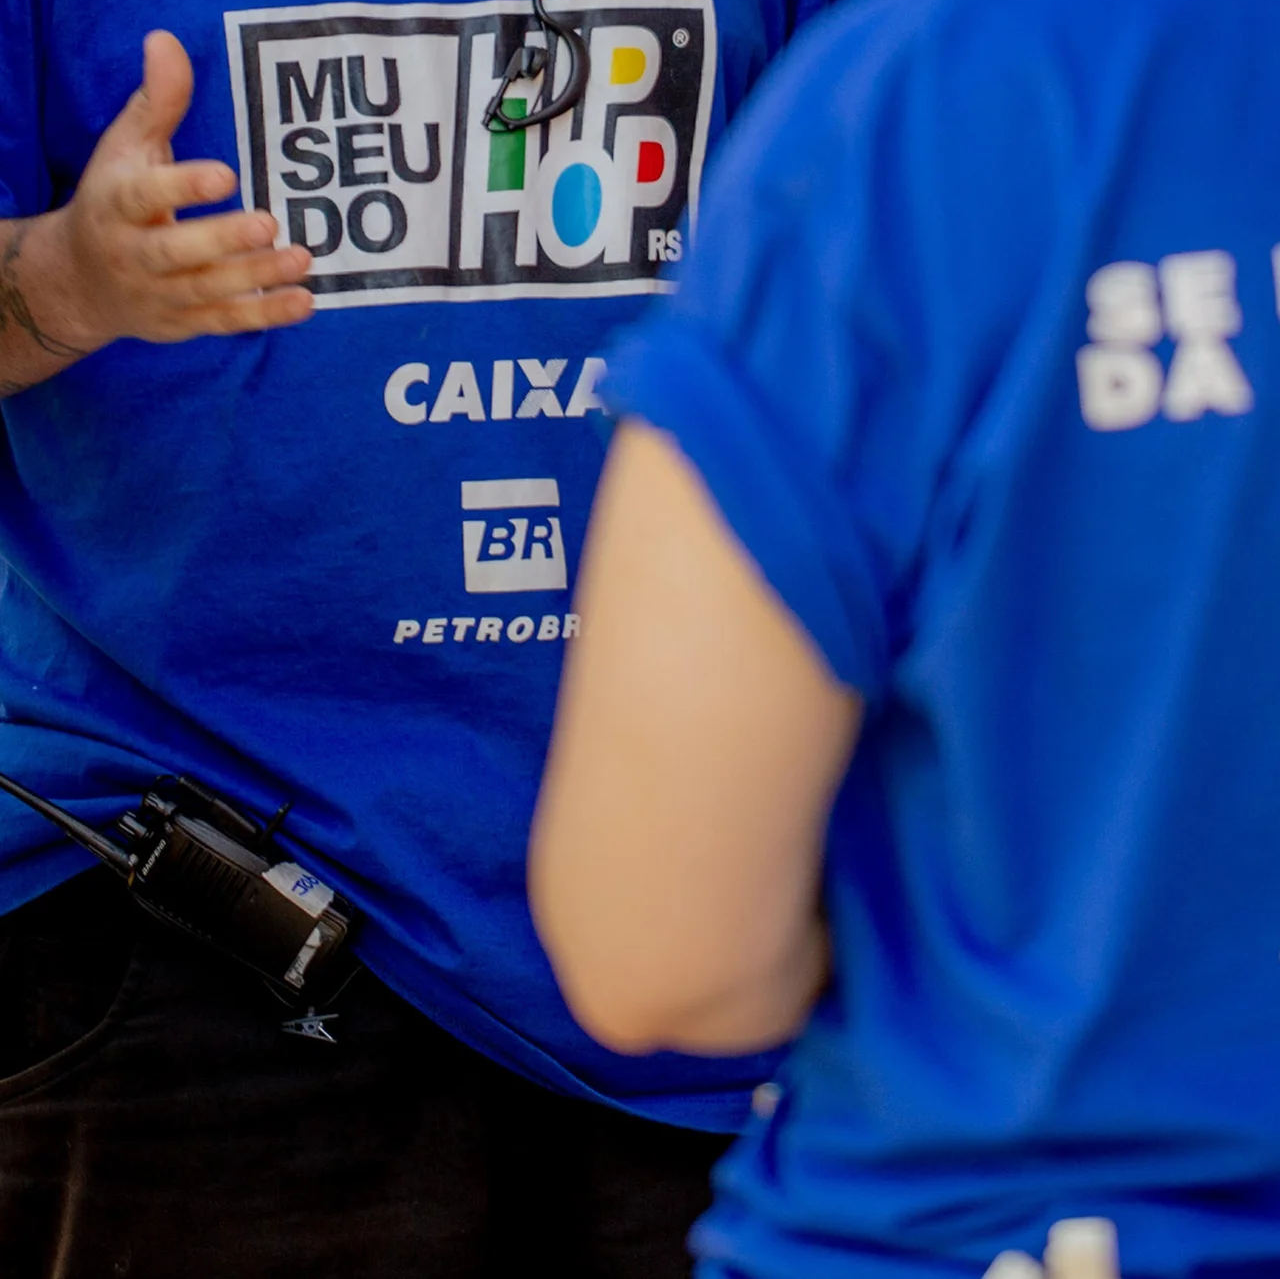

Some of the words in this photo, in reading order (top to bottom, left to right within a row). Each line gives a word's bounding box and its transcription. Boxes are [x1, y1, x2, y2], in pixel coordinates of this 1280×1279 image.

[275, 55, 402, 125] MU
[280, 121, 441, 191] SEU
[286, 189, 408, 258] DO
[458, 115, 679, 270] HOP
[647, 228, 683, 263] RS
[1085, 249, 1243, 348] SE
[1075, 340, 1255, 433] DA
[476, 517, 555, 563] BR
[392, 613, 582, 644] PETROBR
